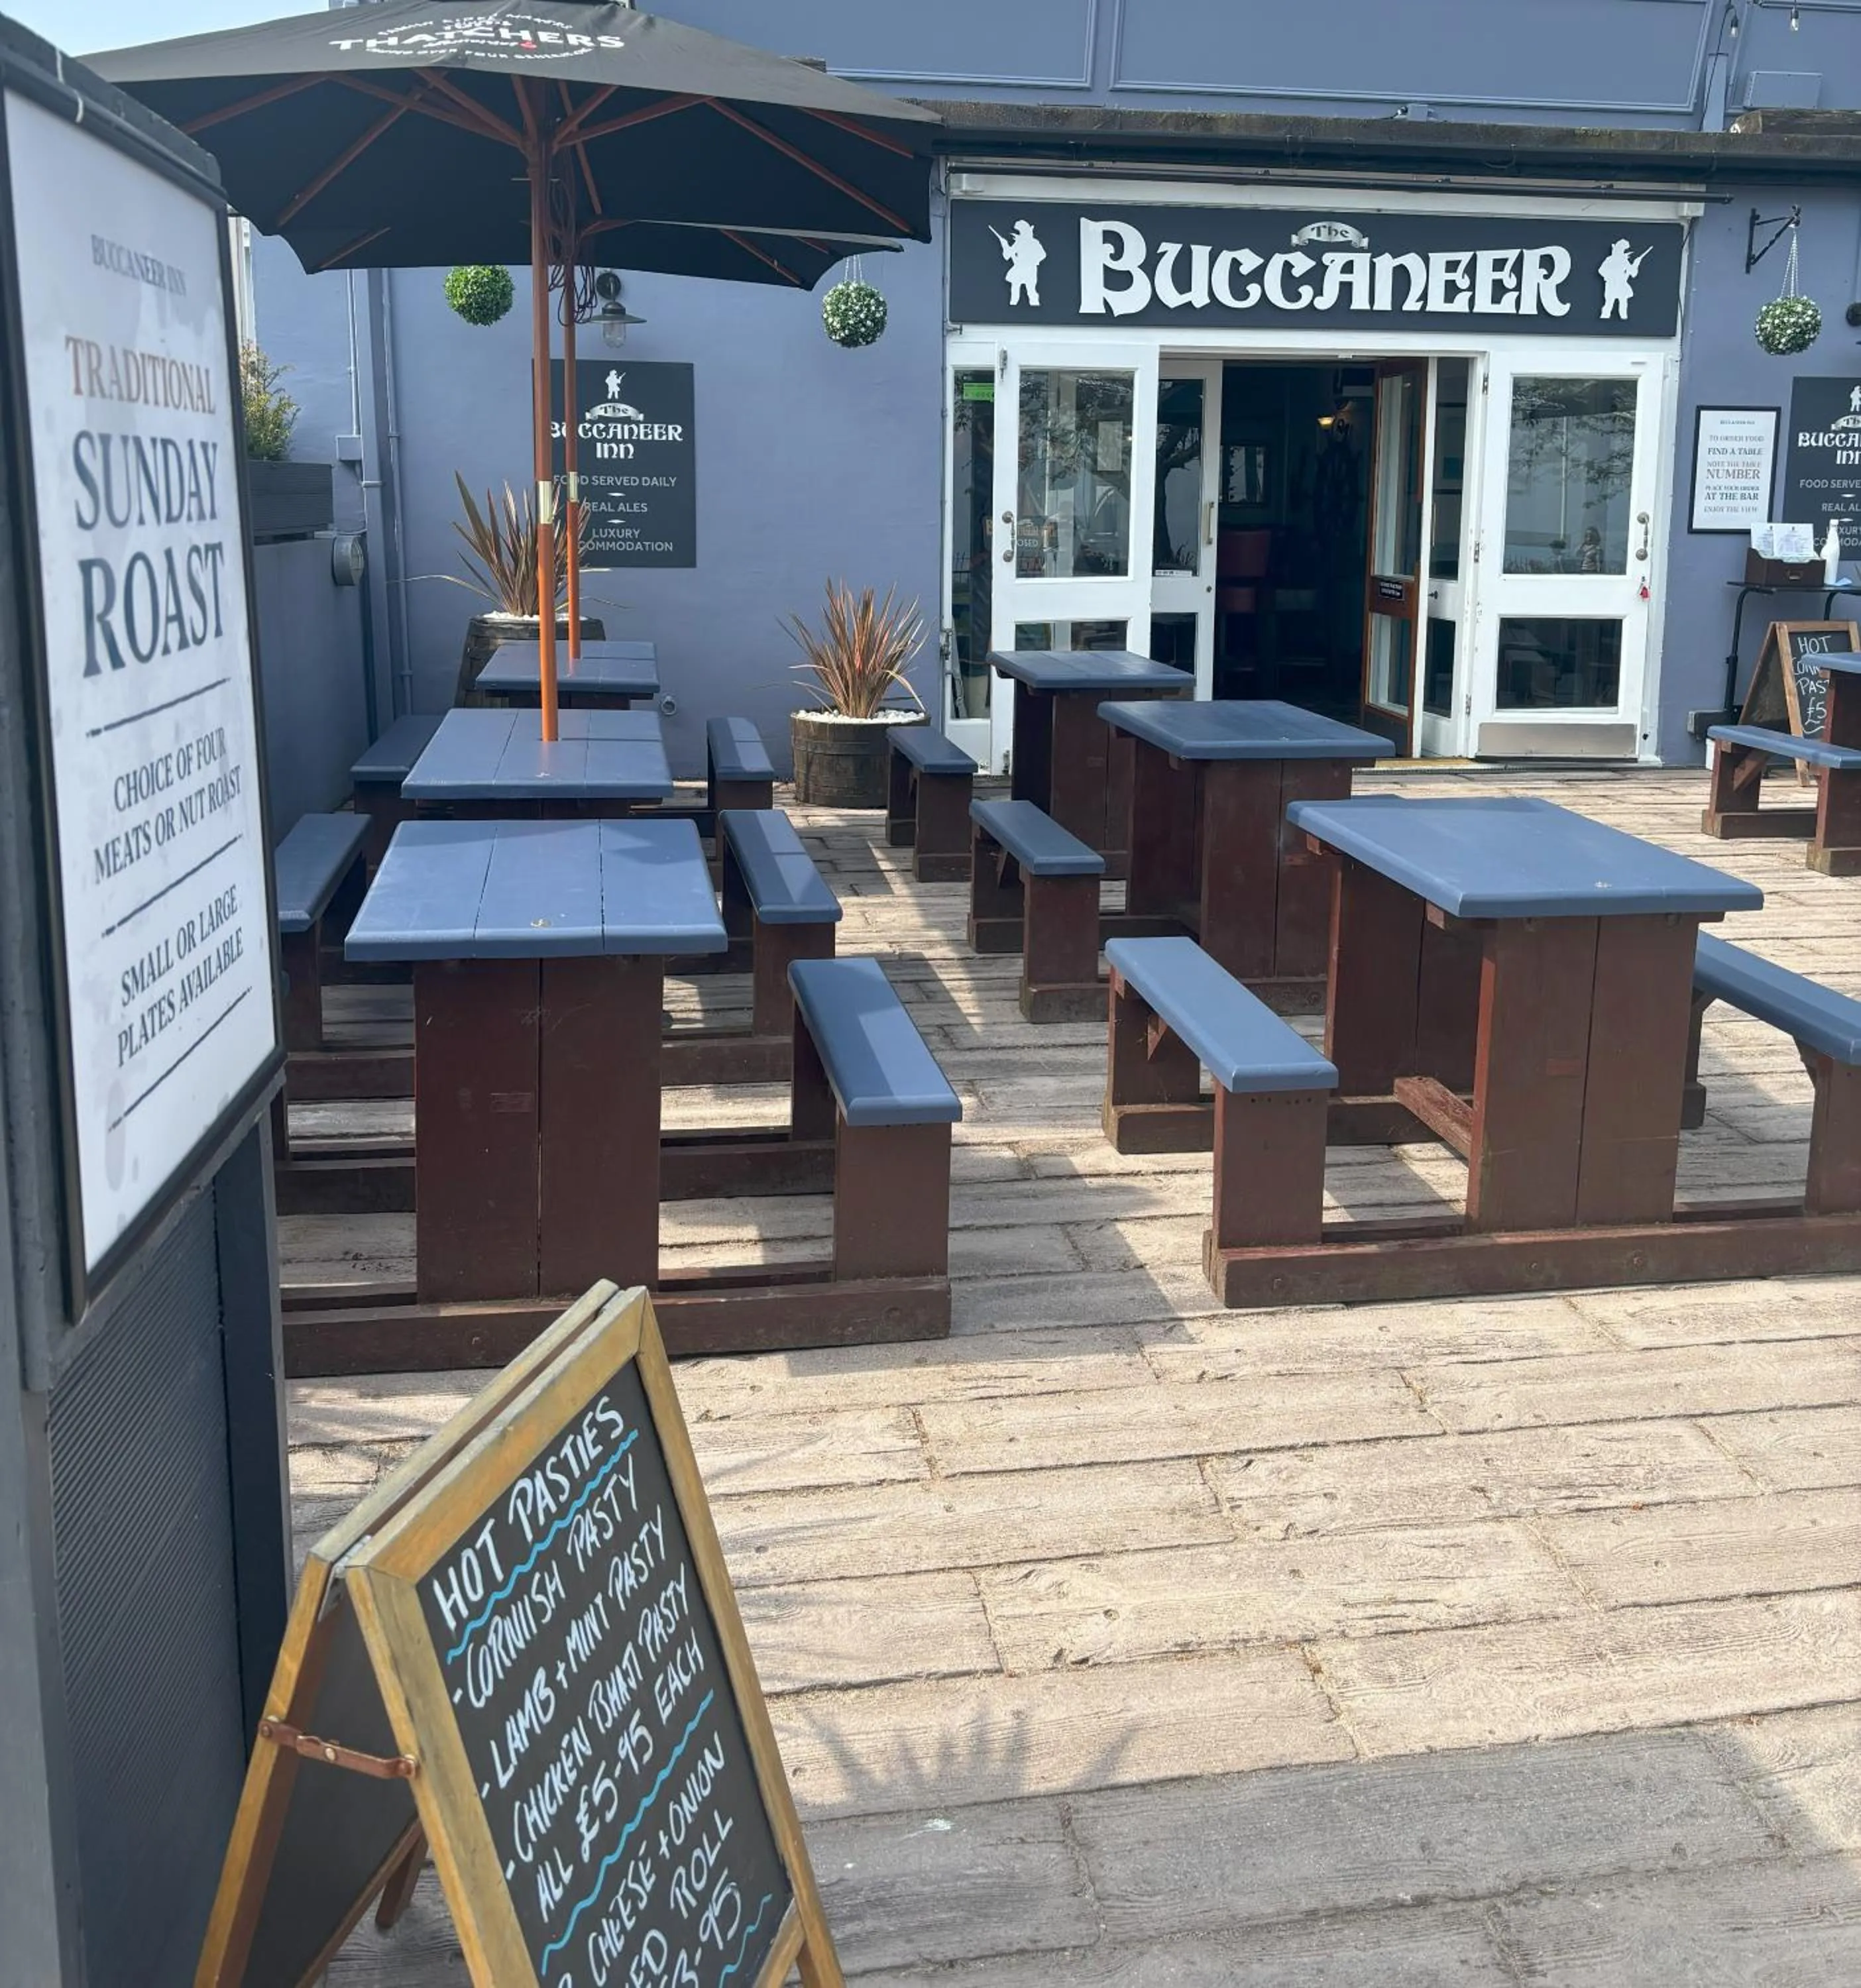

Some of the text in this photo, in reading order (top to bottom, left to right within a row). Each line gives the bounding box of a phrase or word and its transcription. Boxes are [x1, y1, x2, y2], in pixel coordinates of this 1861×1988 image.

[329, 26, 625, 50] THATCHERS
[1078, 217, 1572, 317] BUCCANEER
[1310, 224, 1350, 239] The
[64, 335, 216, 414] TRADITIONAL
[599, 404, 630, 415] The
[72, 430, 218, 531] SUNDAY
[591, 475, 640, 486] SERVED
[642, 476, 677, 487] DAILY
[596, 442, 634, 459] INN
[1706, 469, 1760, 479] NUMBER
[1797, 432, 1861, 447] BUCCA
[617, 502, 648, 513] ALES
[1799, 479, 1829, 488] FOOD
[1822, 503, 1846, 512] REAL
[592, 528, 640, 538] LUXURY
[78, 541, 225, 679] ROAST
[1797, 635, 1832, 653] HOT
[114, 727, 226, 812] CHOICE OF FOUR
[94, 765, 241, 885] MEATS OR NUT ROAST
[121, 884, 238, 1007] SMALL OR LARGE
[118, 926, 244, 1068] PLATES AVAILABLE
[433, 1396, 624, 1632] HOT PASTIES
[567, 1452, 638, 1573] PASTY
[490, 1666, 556, 1789] LAMB
[565, 1592, 610, 1674] MINT
[608, 1504, 665, 1612] PASTY
[514, 1716, 592, 1863] CHICKEN
[638, 1562, 689, 1663] PASTY
[537, 1846, 574, 1923] ALL
[654, 1626, 705, 1725] EACH
[589, 1840, 656, 1987] CHEESE
[669, 1730, 725, 1846] ONION
[670, 1808, 733, 1919] ROLL
